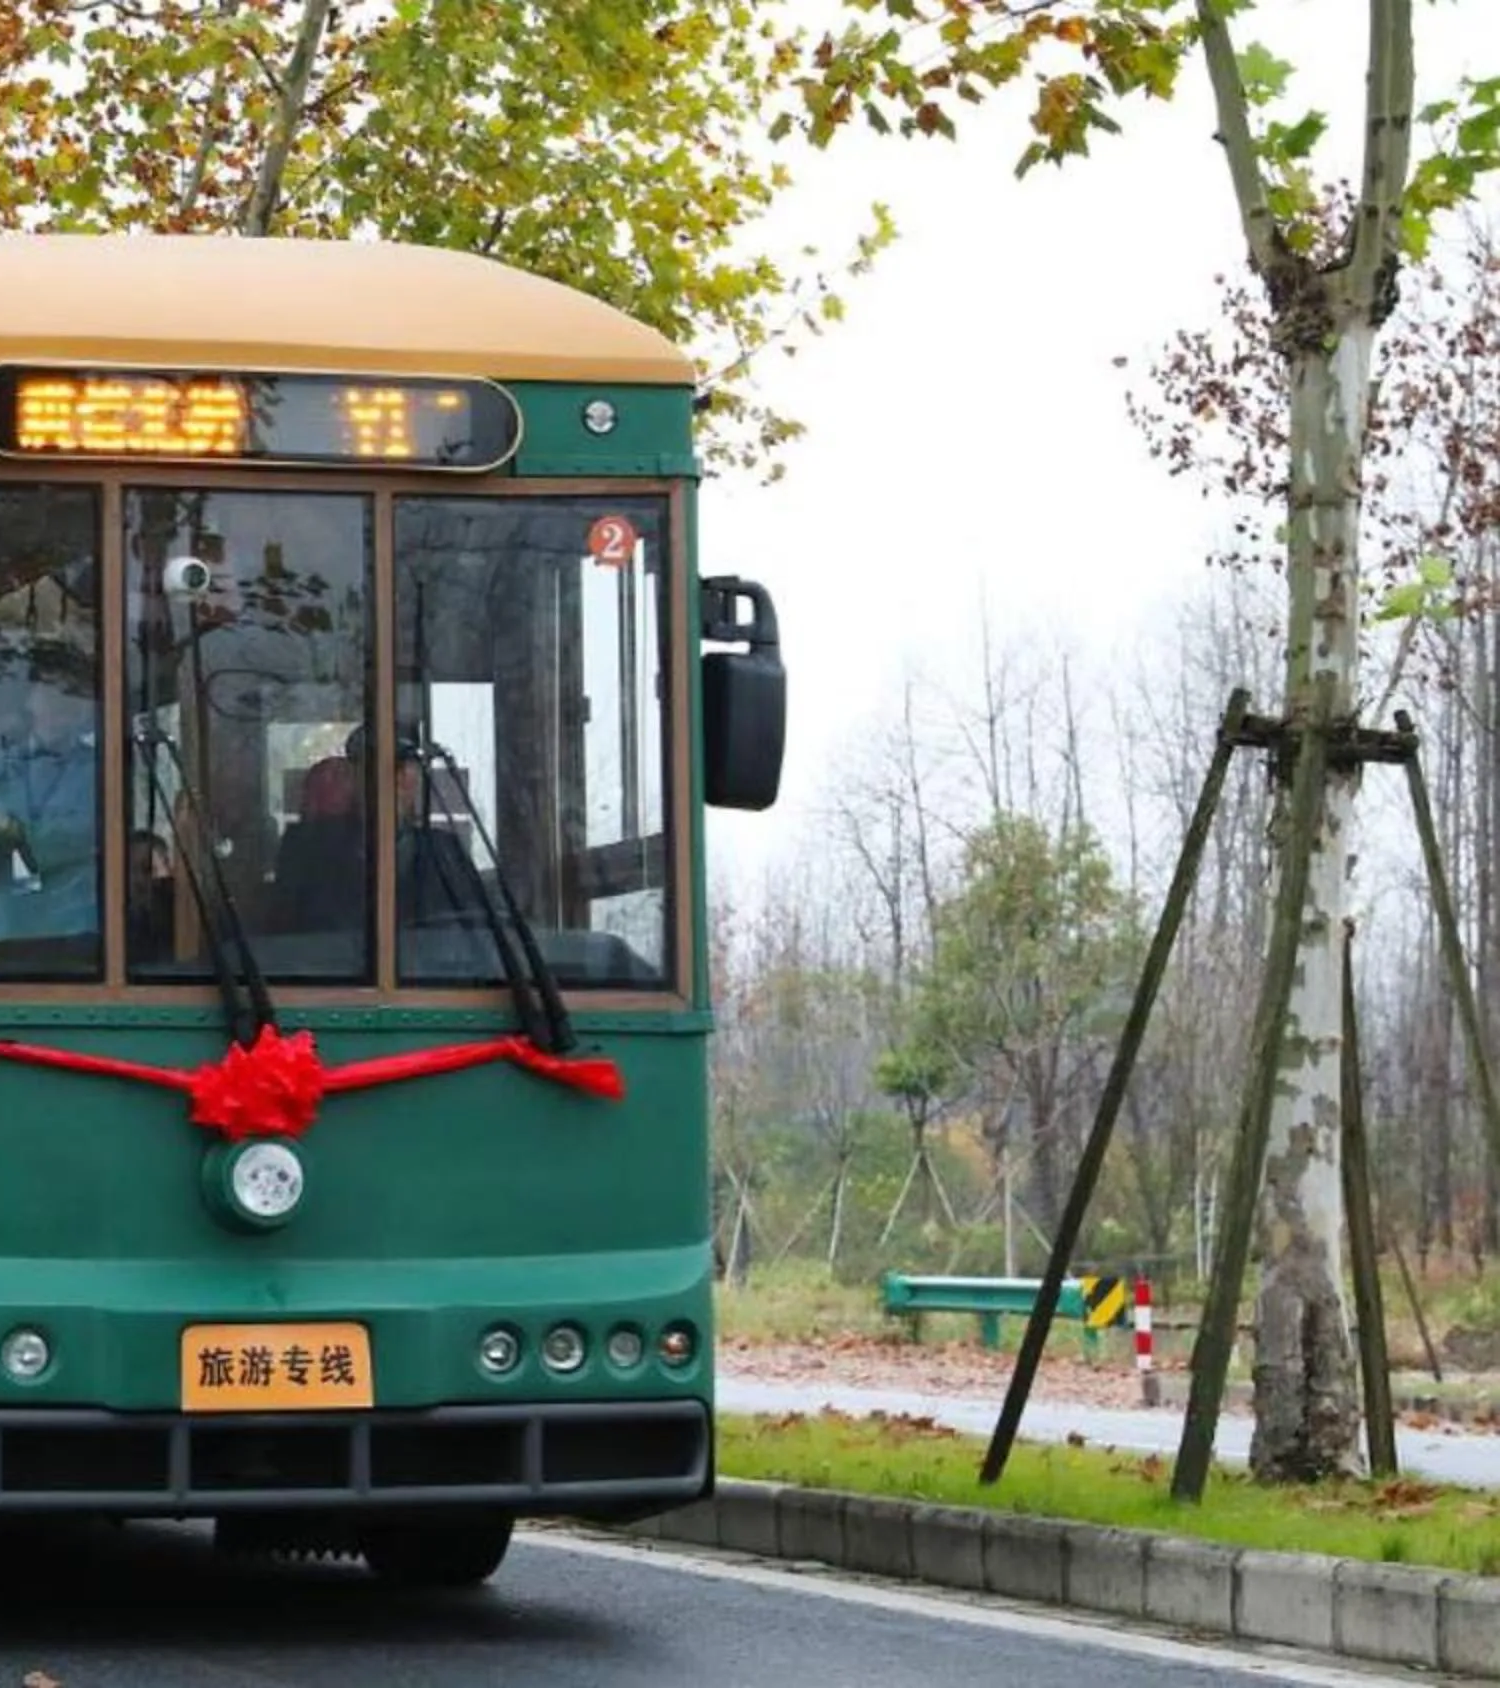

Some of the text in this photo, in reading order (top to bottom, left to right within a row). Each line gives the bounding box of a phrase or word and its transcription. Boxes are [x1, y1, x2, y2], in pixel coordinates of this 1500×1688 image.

[601, 522, 625, 558] 2
[197, 1344, 356, 1389] 旅游专线
